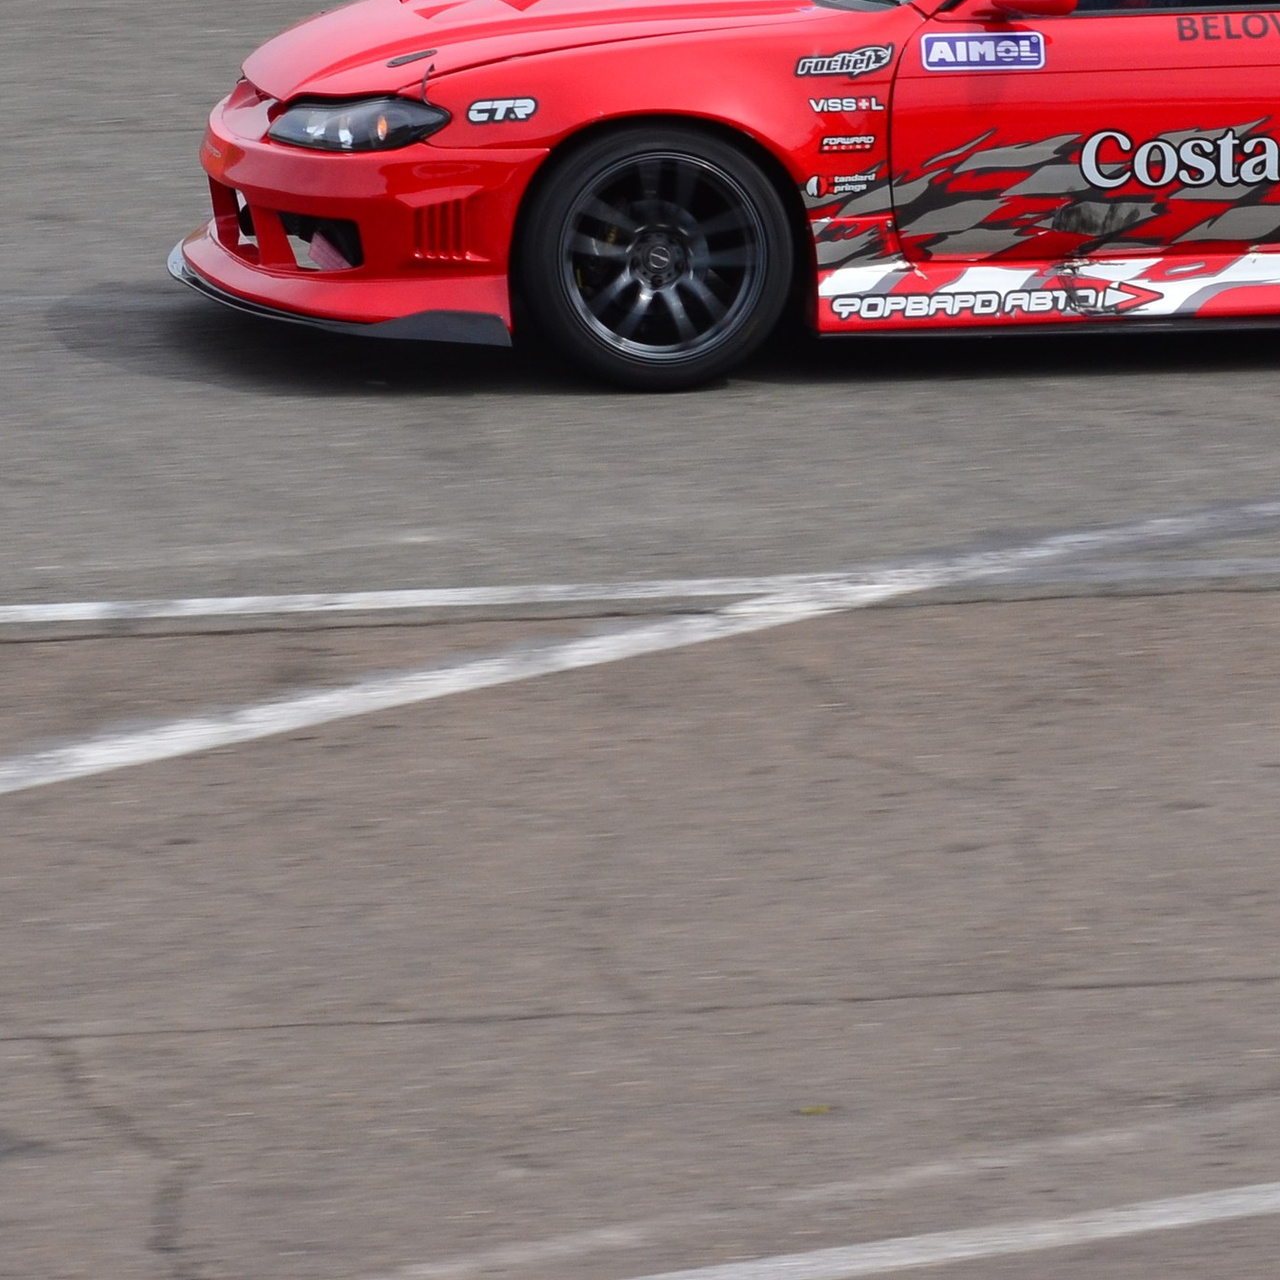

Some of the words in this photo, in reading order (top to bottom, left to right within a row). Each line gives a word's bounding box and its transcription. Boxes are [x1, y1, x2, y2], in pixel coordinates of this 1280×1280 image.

[927, 40, 1040, 62] AIMOL
[1081, 130, 1280, 189] Costa
[832, 291, 1000, 319] ФОРВАРД
